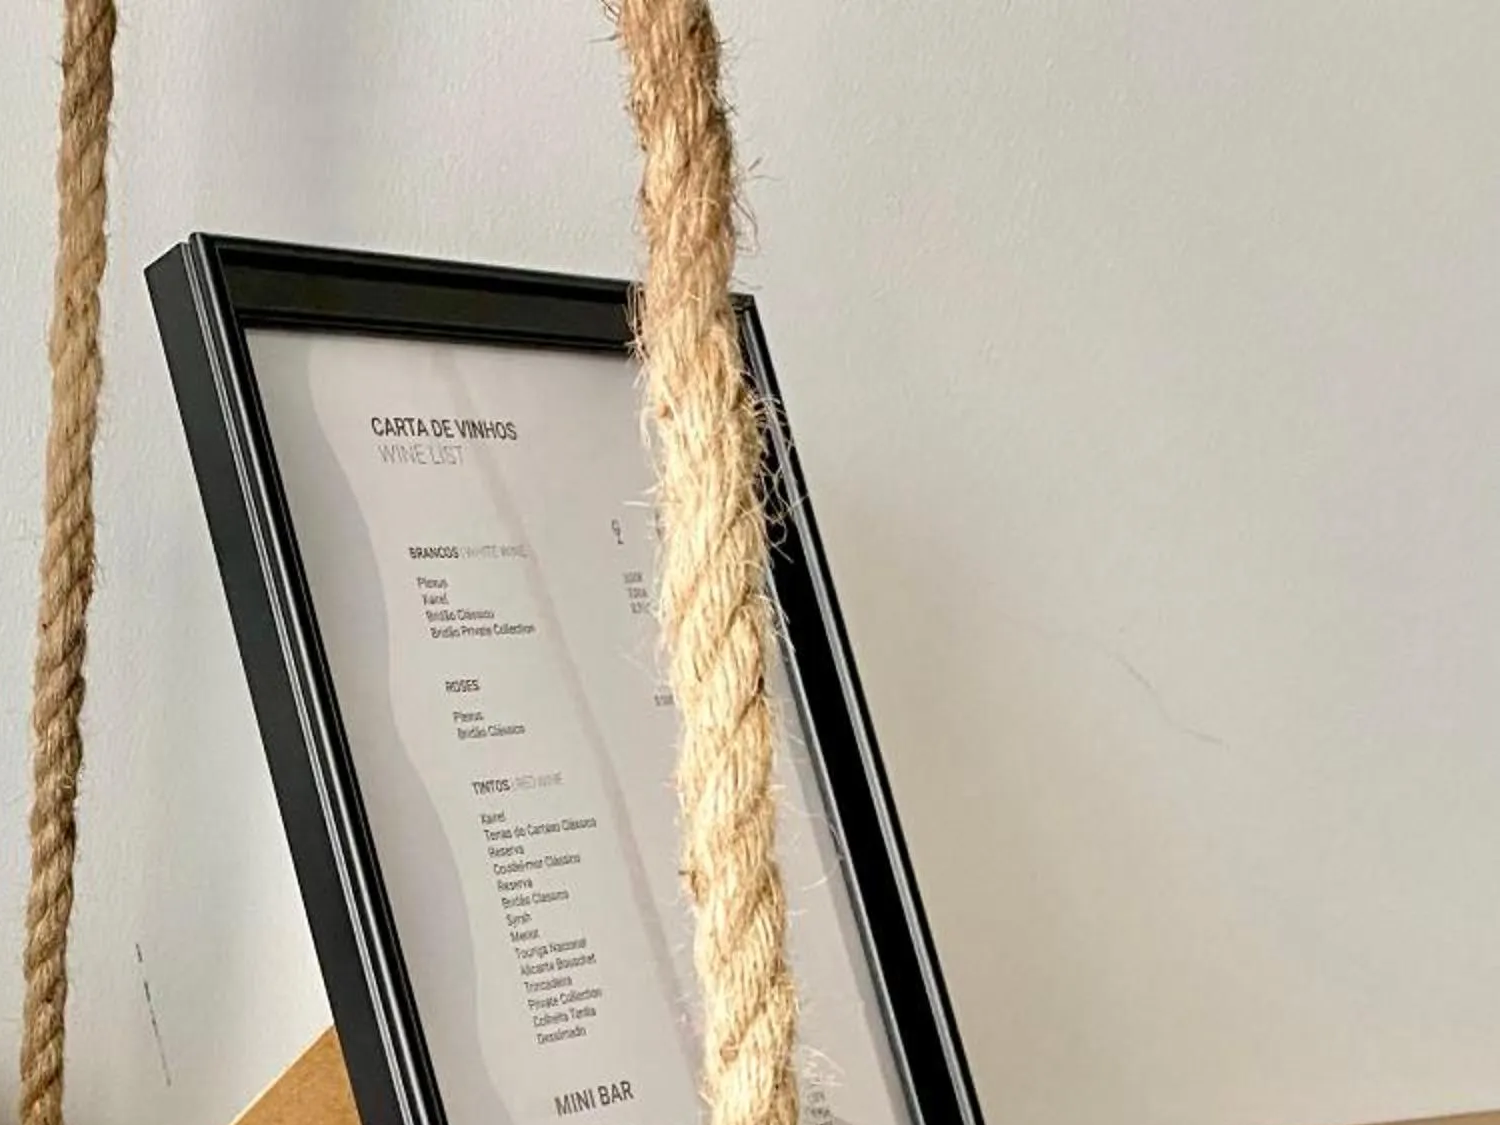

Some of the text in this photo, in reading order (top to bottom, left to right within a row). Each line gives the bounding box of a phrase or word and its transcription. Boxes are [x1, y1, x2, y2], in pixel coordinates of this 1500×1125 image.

[371, 417, 517, 440] CARTA DE VINHOS
[377, 444, 464, 465] WINE LIST
[408, 546, 459, 559] BRANCOS
[554, 1080, 634, 1116] MINI BAR
